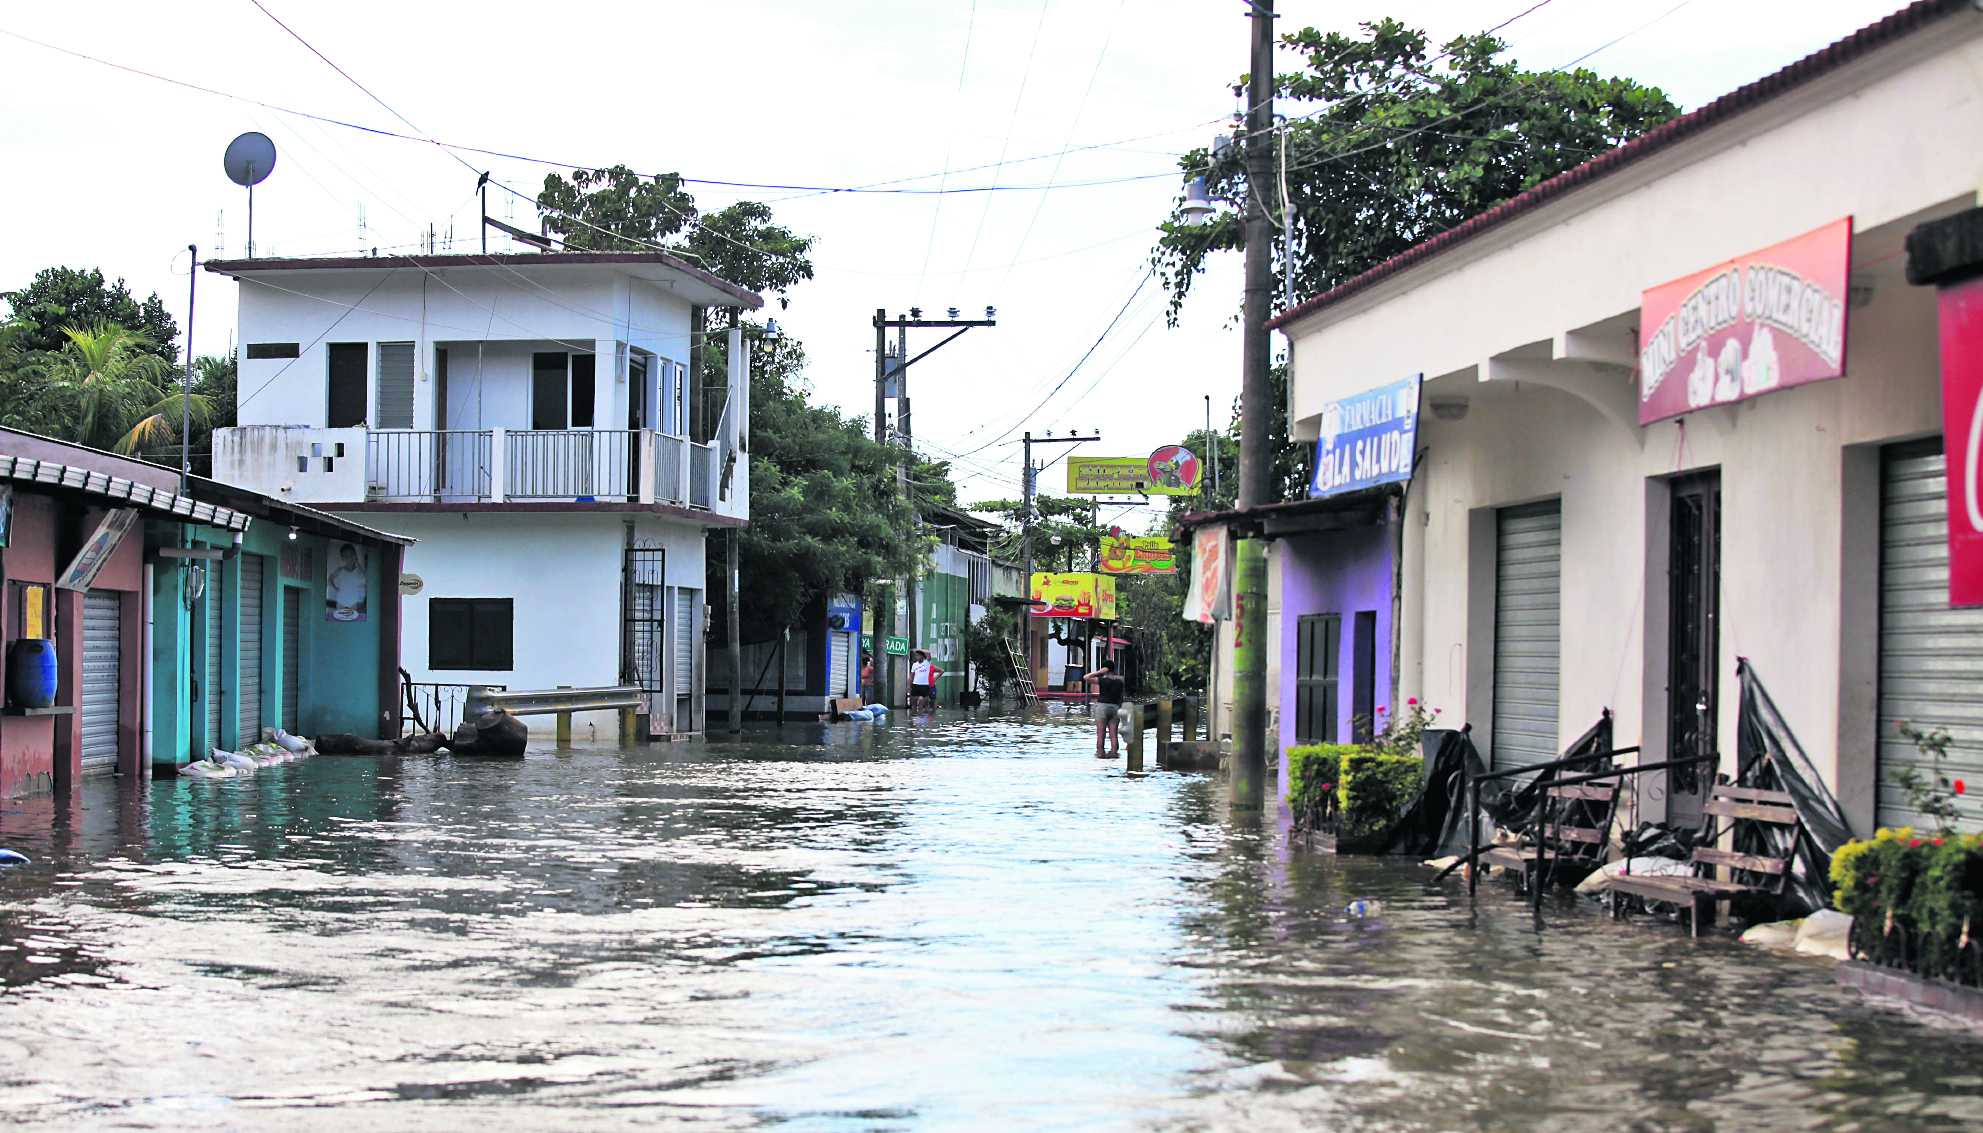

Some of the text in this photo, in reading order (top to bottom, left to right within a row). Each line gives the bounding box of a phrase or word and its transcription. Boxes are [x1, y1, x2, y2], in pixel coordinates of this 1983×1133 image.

[1641, 264, 1842, 402] MINI CENTRO COMERCIAL
[1079, 465, 1150, 478] SUPER
[1333, 430, 1401, 487] LA SALUD
[1143, 541, 1159, 549] Pollo
